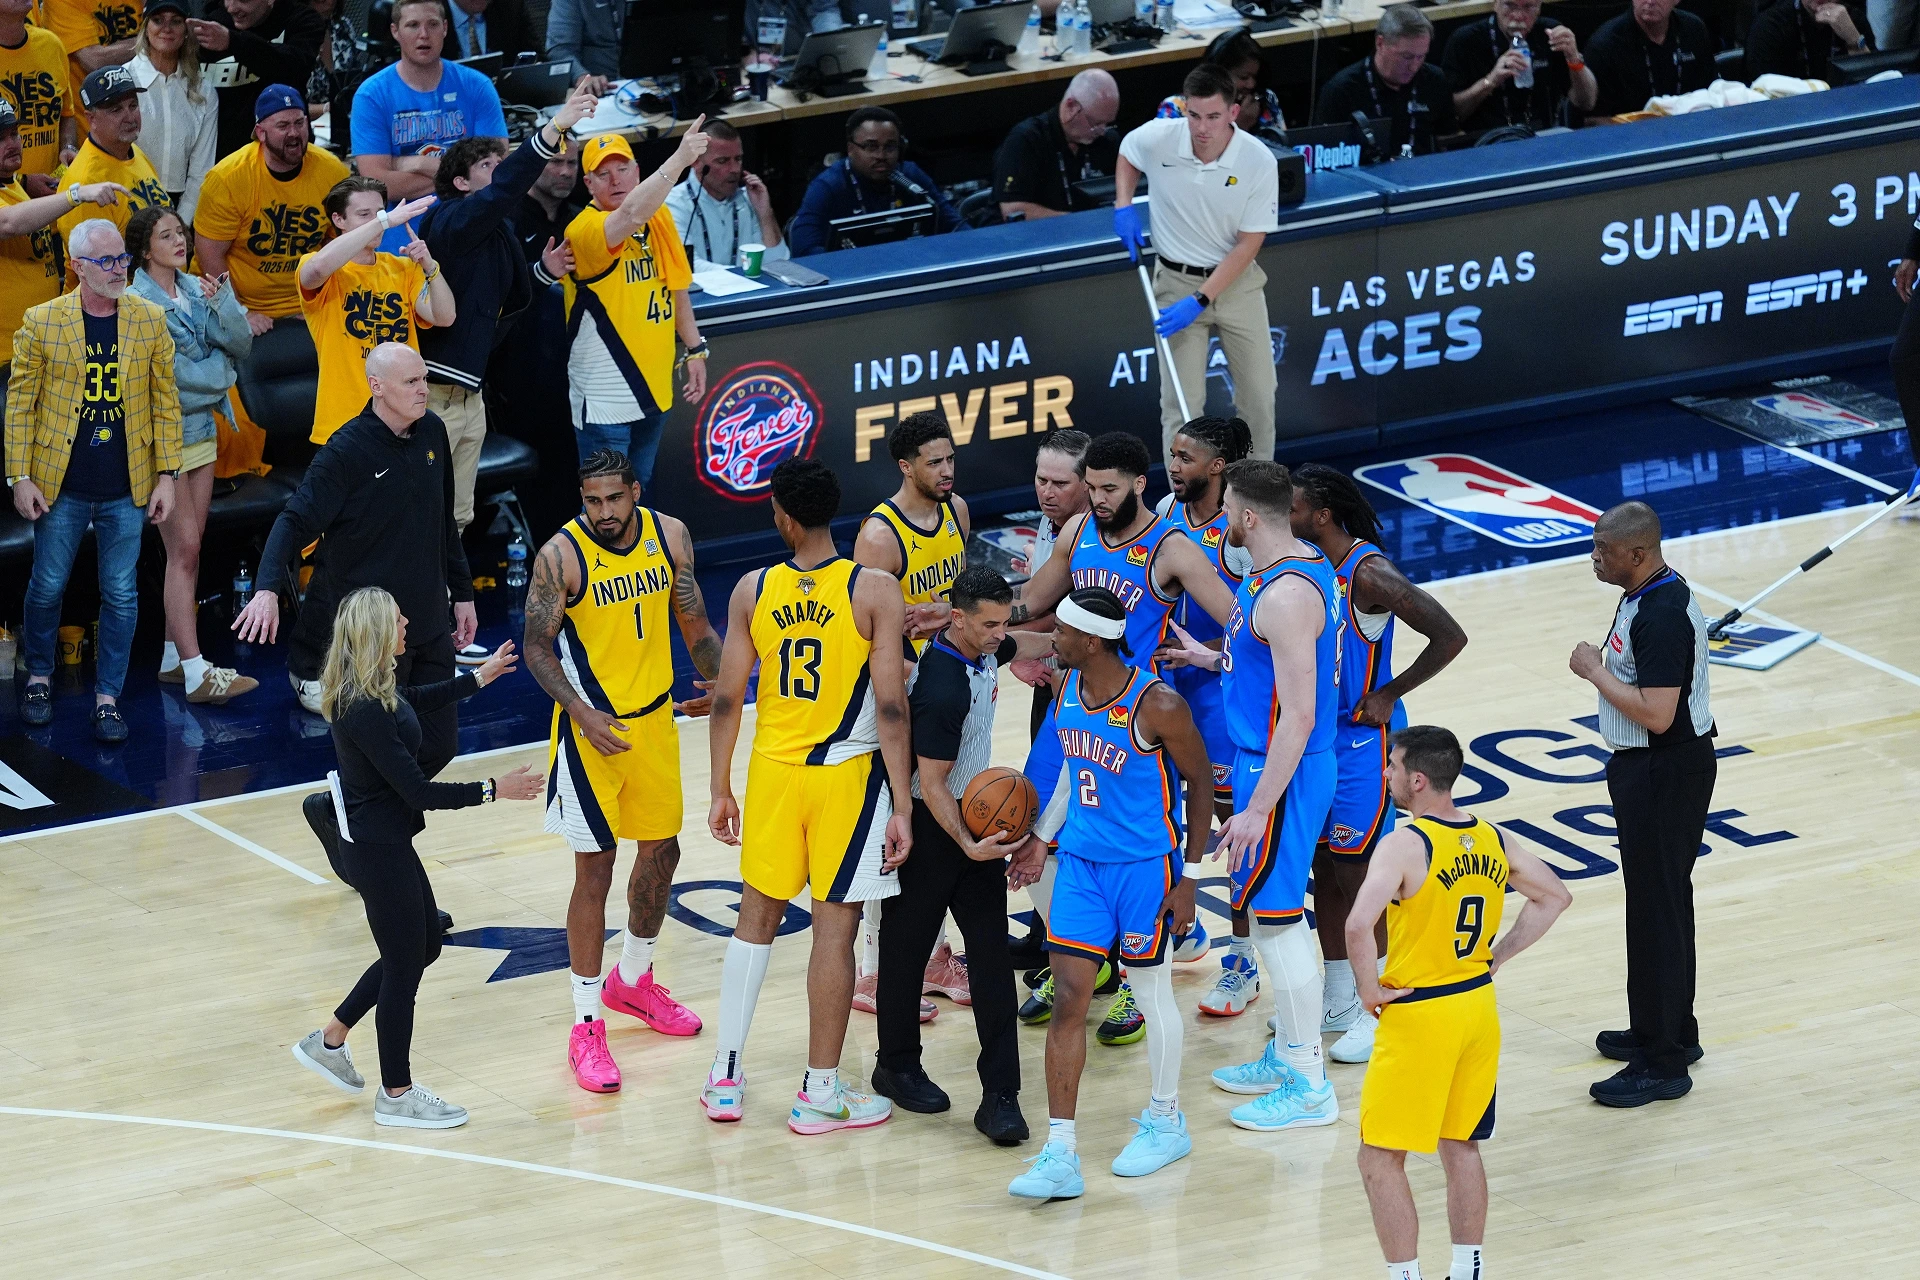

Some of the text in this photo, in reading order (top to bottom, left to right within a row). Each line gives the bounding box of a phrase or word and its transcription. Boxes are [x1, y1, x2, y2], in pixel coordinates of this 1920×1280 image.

[95, 5, 138, 36] YES
[0, 72, 56, 103] YES
[11, 96, 63, 127] ERS
[1313, 141, 1361, 170] Replay
[263, 203, 320, 233] YES
[1600, 191, 1800, 266] SUNDAY
[1828, 183, 1857, 227] 3
[258, 261, 284, 274] 2025
[624, 256, 659, 285] INDI
[1311, 251, 1536, 317] LAS VEGAS
[351, 290, 404, 320] YES
[646, 285, 673, 325] 43
[1623, 290, 1724, 337] ESPN
[1745, 269, 1868, 315] ESPN+
[854, 336, 1030, 393] INDIANA
[1310, 305, 1483, 385] ACES
[84, 362, 122, 402] 33
[1109, 347, 1156, 387] AT
[719, 382, 790, 417] INDIANA
[706, 399, 813, 476] Fever
[1502, 519, 1583, 542] NBA
[592, 564, 670, 608] INDIANA
[633, 602, 644, 641] 1
[771, 600, 836, 631] BRADLEY
[778, 637, 823, 703] 13
[1078, 768, 1101, 809] 2
[1334, 829, 1351, 839] OKC
[1124, 937, 1141, 947] OKC
[1454, 894, 1486, 961] 9
